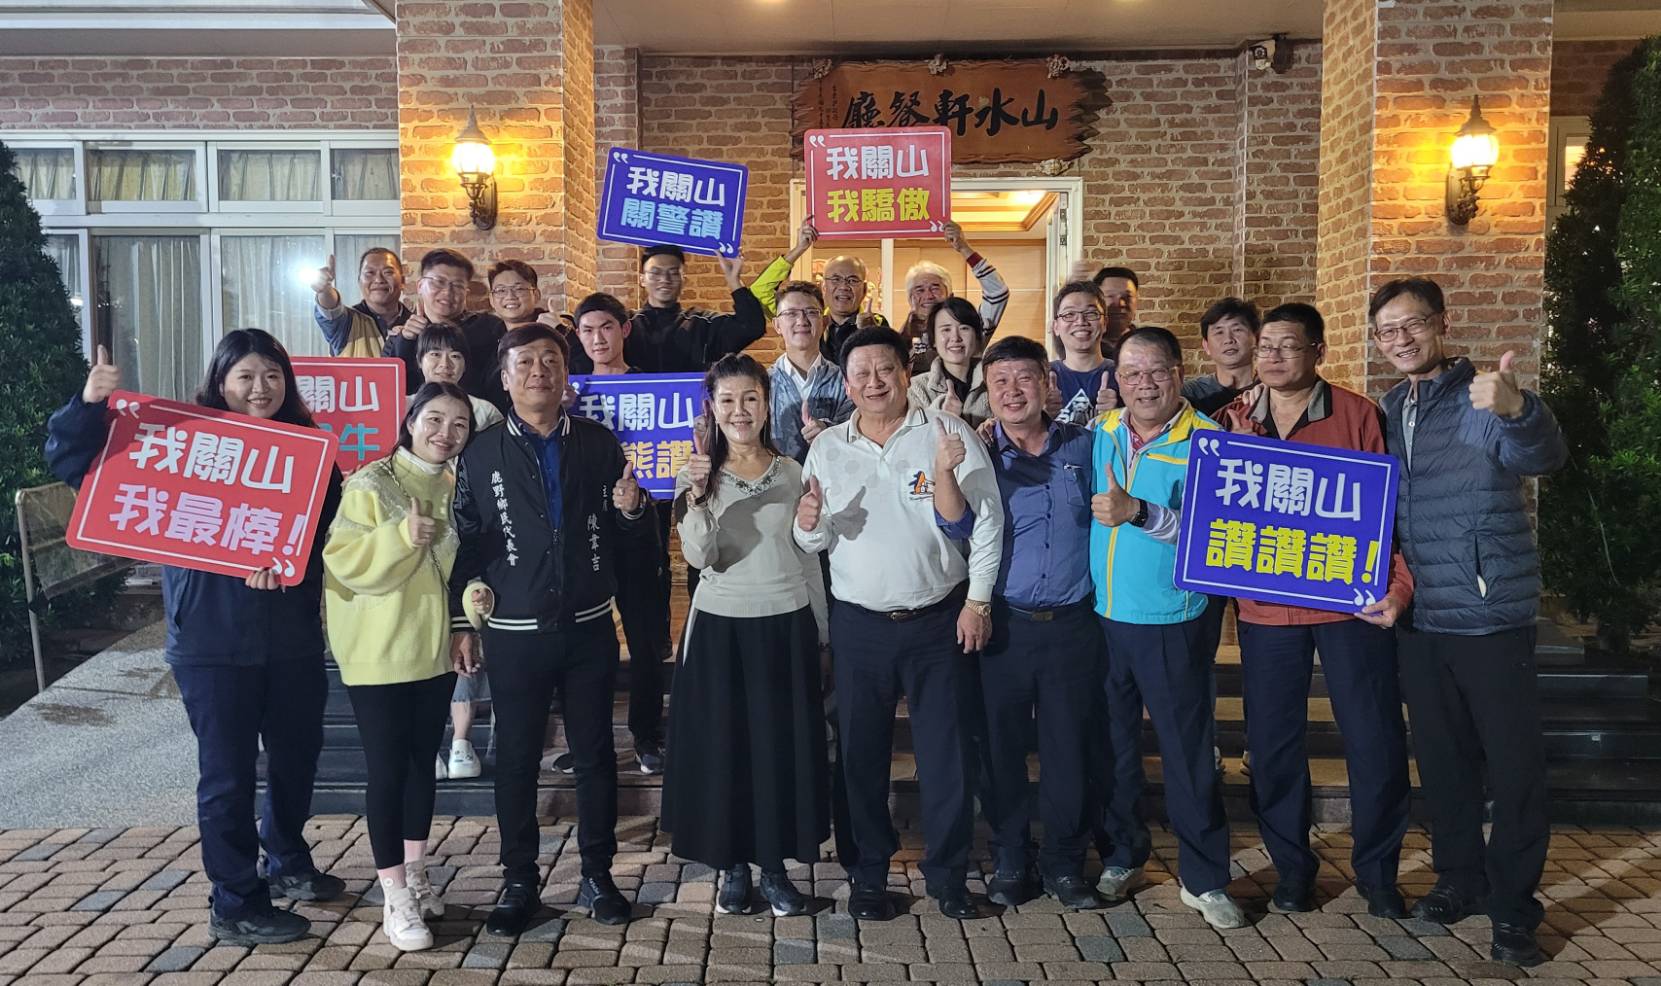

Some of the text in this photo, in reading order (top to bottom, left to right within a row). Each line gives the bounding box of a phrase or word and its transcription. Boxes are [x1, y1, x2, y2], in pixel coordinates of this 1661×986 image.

[626, 166, 726, 207] 我關山
[826, 144, 929, 180] 我關山
[620, 197, 724, 240] 關警讚
[580, 392, 694, 431] 我關山
[128, 422, 295, 494] 我關山
[319, 422, 380, 461] 牛
[1215, 458, 1361, 521] 我關山
[109, 482, 306, 556] 我最棒!
[490, 470, 519, 567] 鹿野鄉民代表會
[1205, 518, 1379, 585] 讚讚讚!
